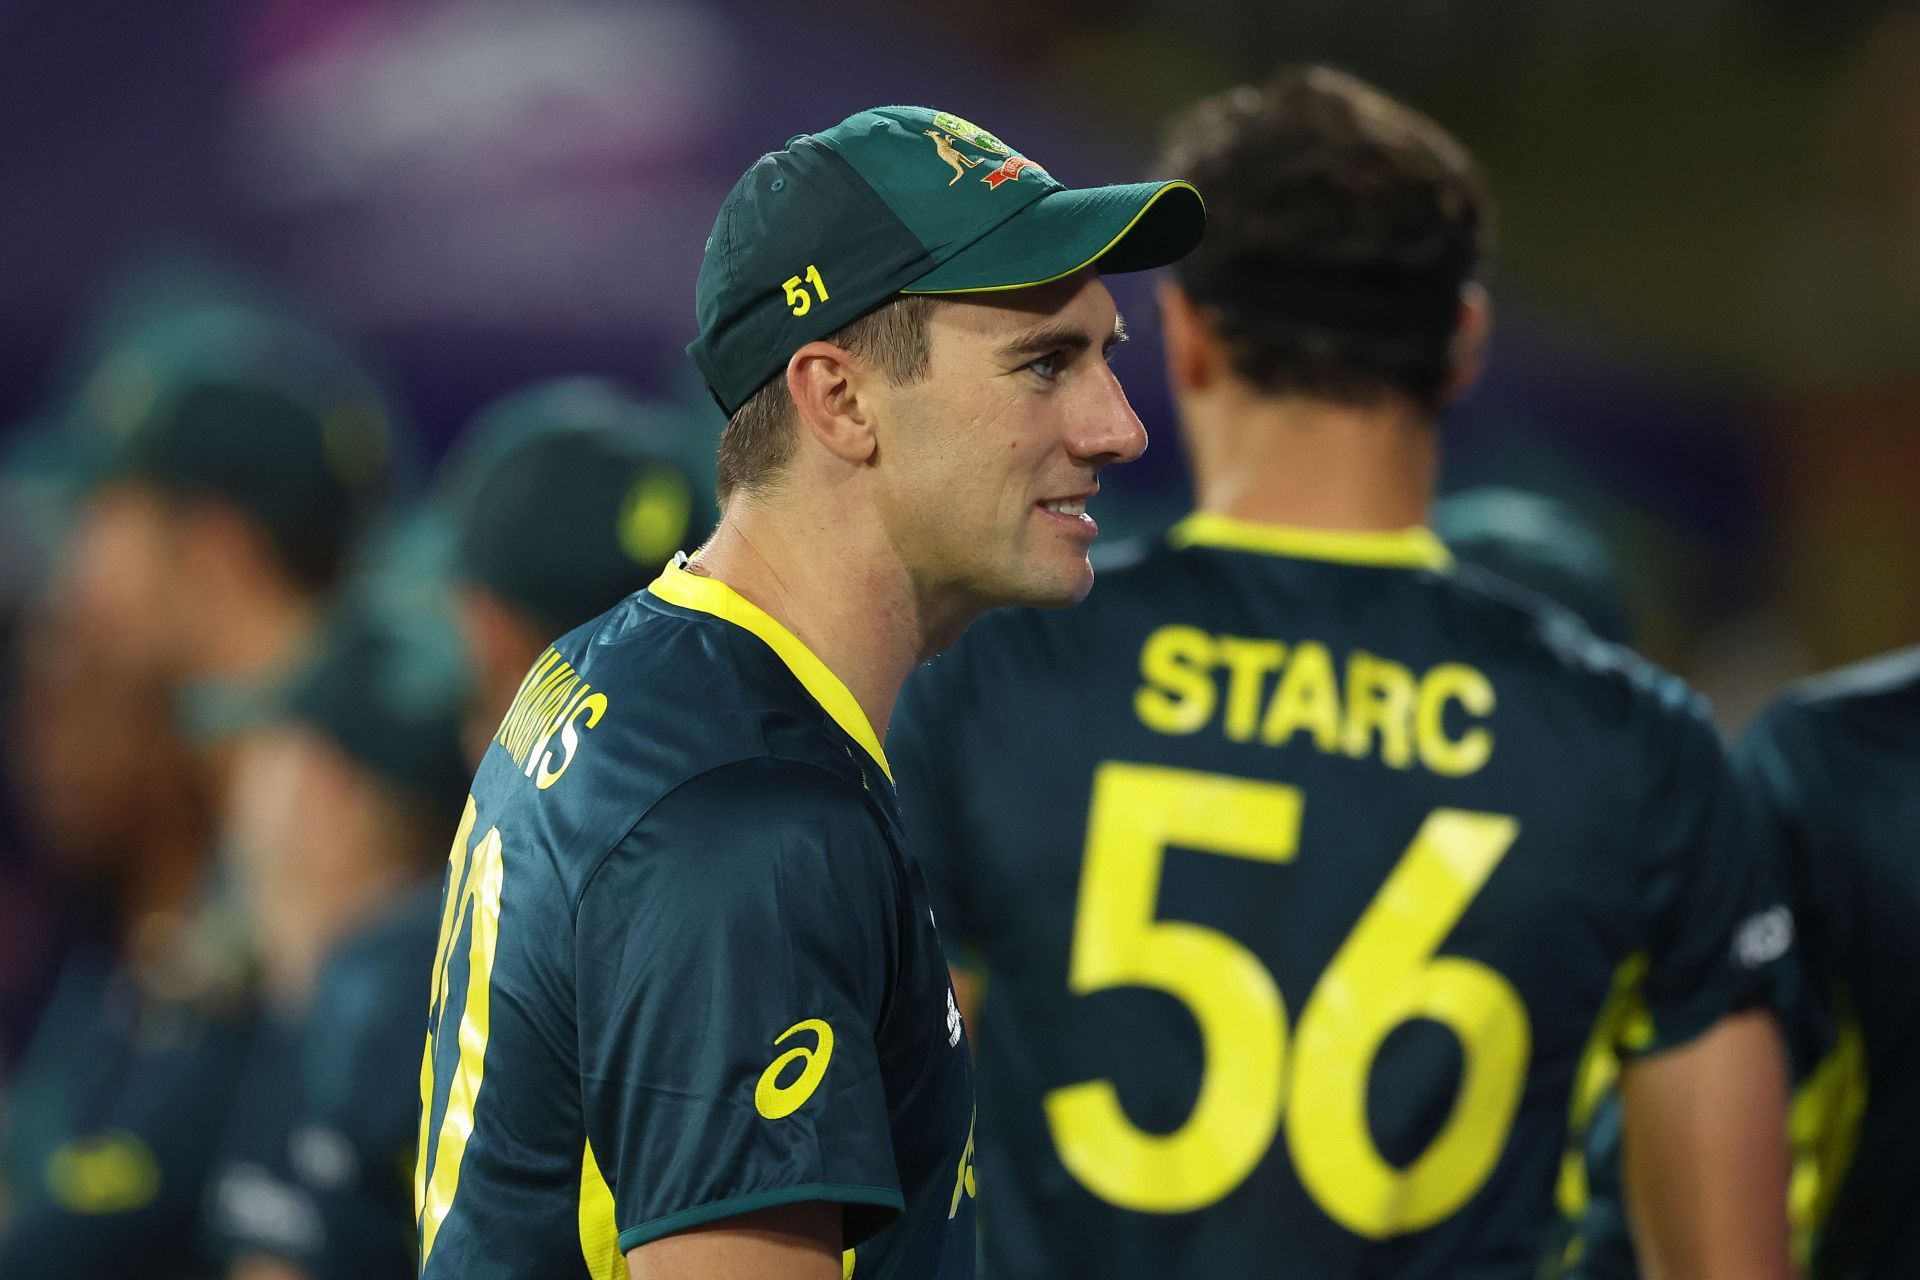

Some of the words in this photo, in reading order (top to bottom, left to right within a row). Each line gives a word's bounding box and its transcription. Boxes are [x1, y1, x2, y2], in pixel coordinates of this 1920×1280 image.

[781, 264, 830, 317] 51
[1134, 624, 1496, 777] STARC
[1043, 760, 1533, 1241] 56
